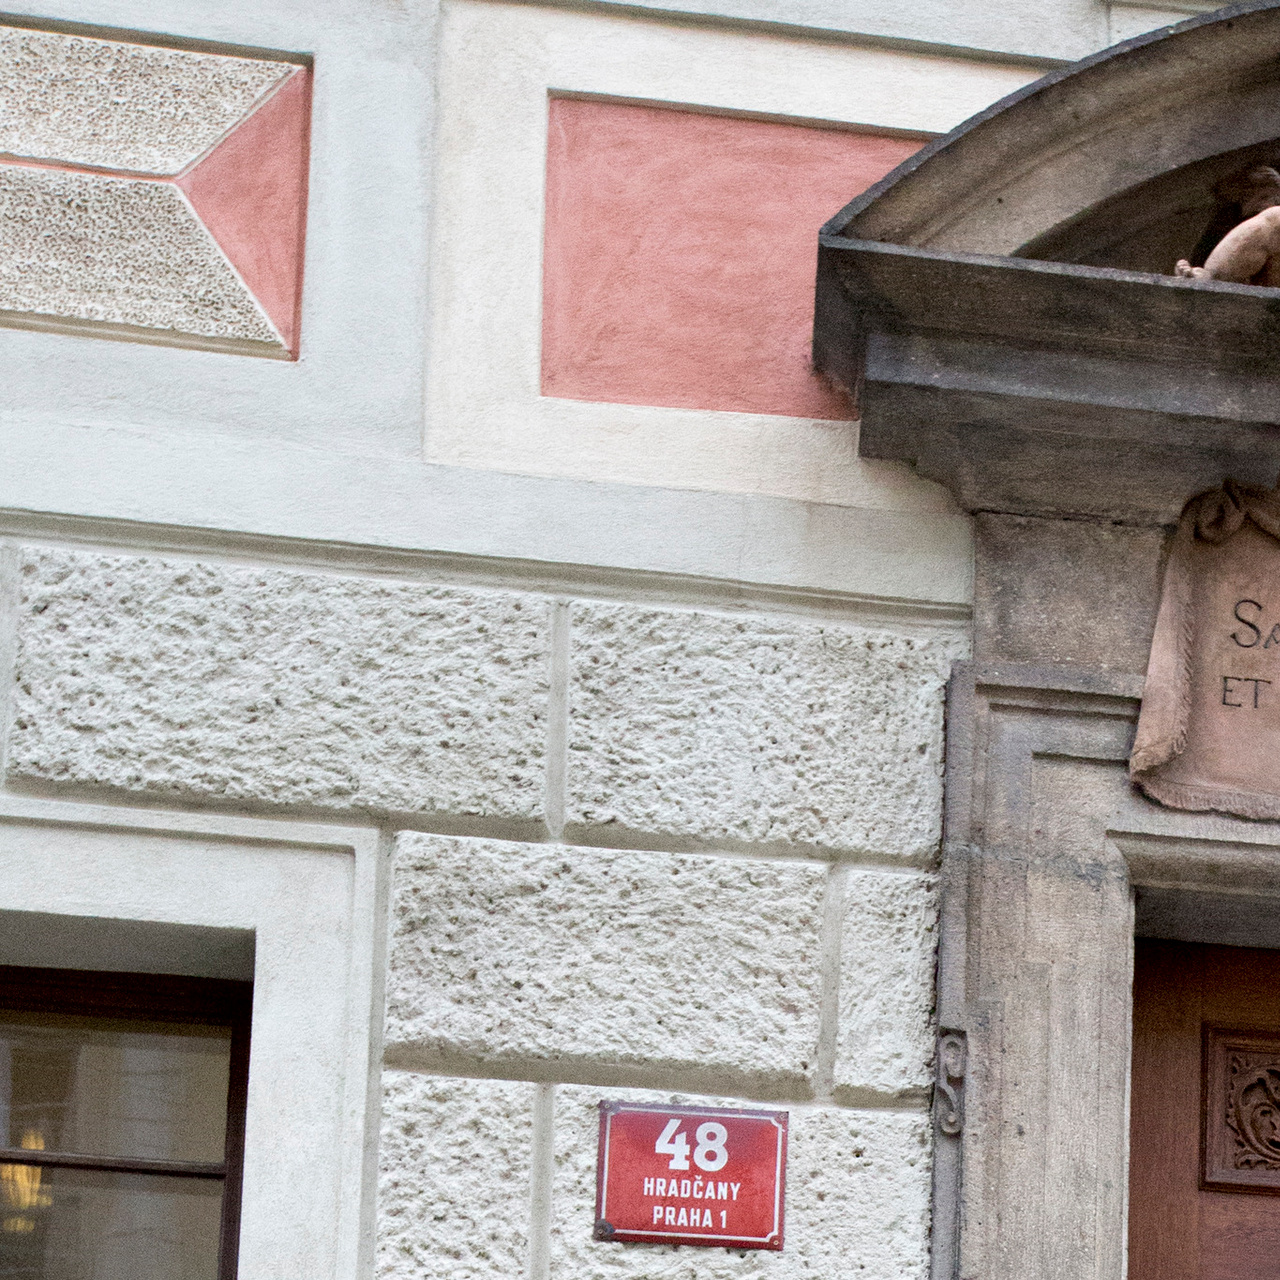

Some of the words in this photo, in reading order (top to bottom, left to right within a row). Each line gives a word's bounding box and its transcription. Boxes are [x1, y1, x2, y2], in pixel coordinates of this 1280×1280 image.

[1221, 676, 1272, 708] ET
[655, 1118, 729, 1172] 48
[643, 1175, 741, 1201] HRADČANY
[653, 1205, 713, 1228] PRAHA
[720, 1210, 727, 1228] 1
